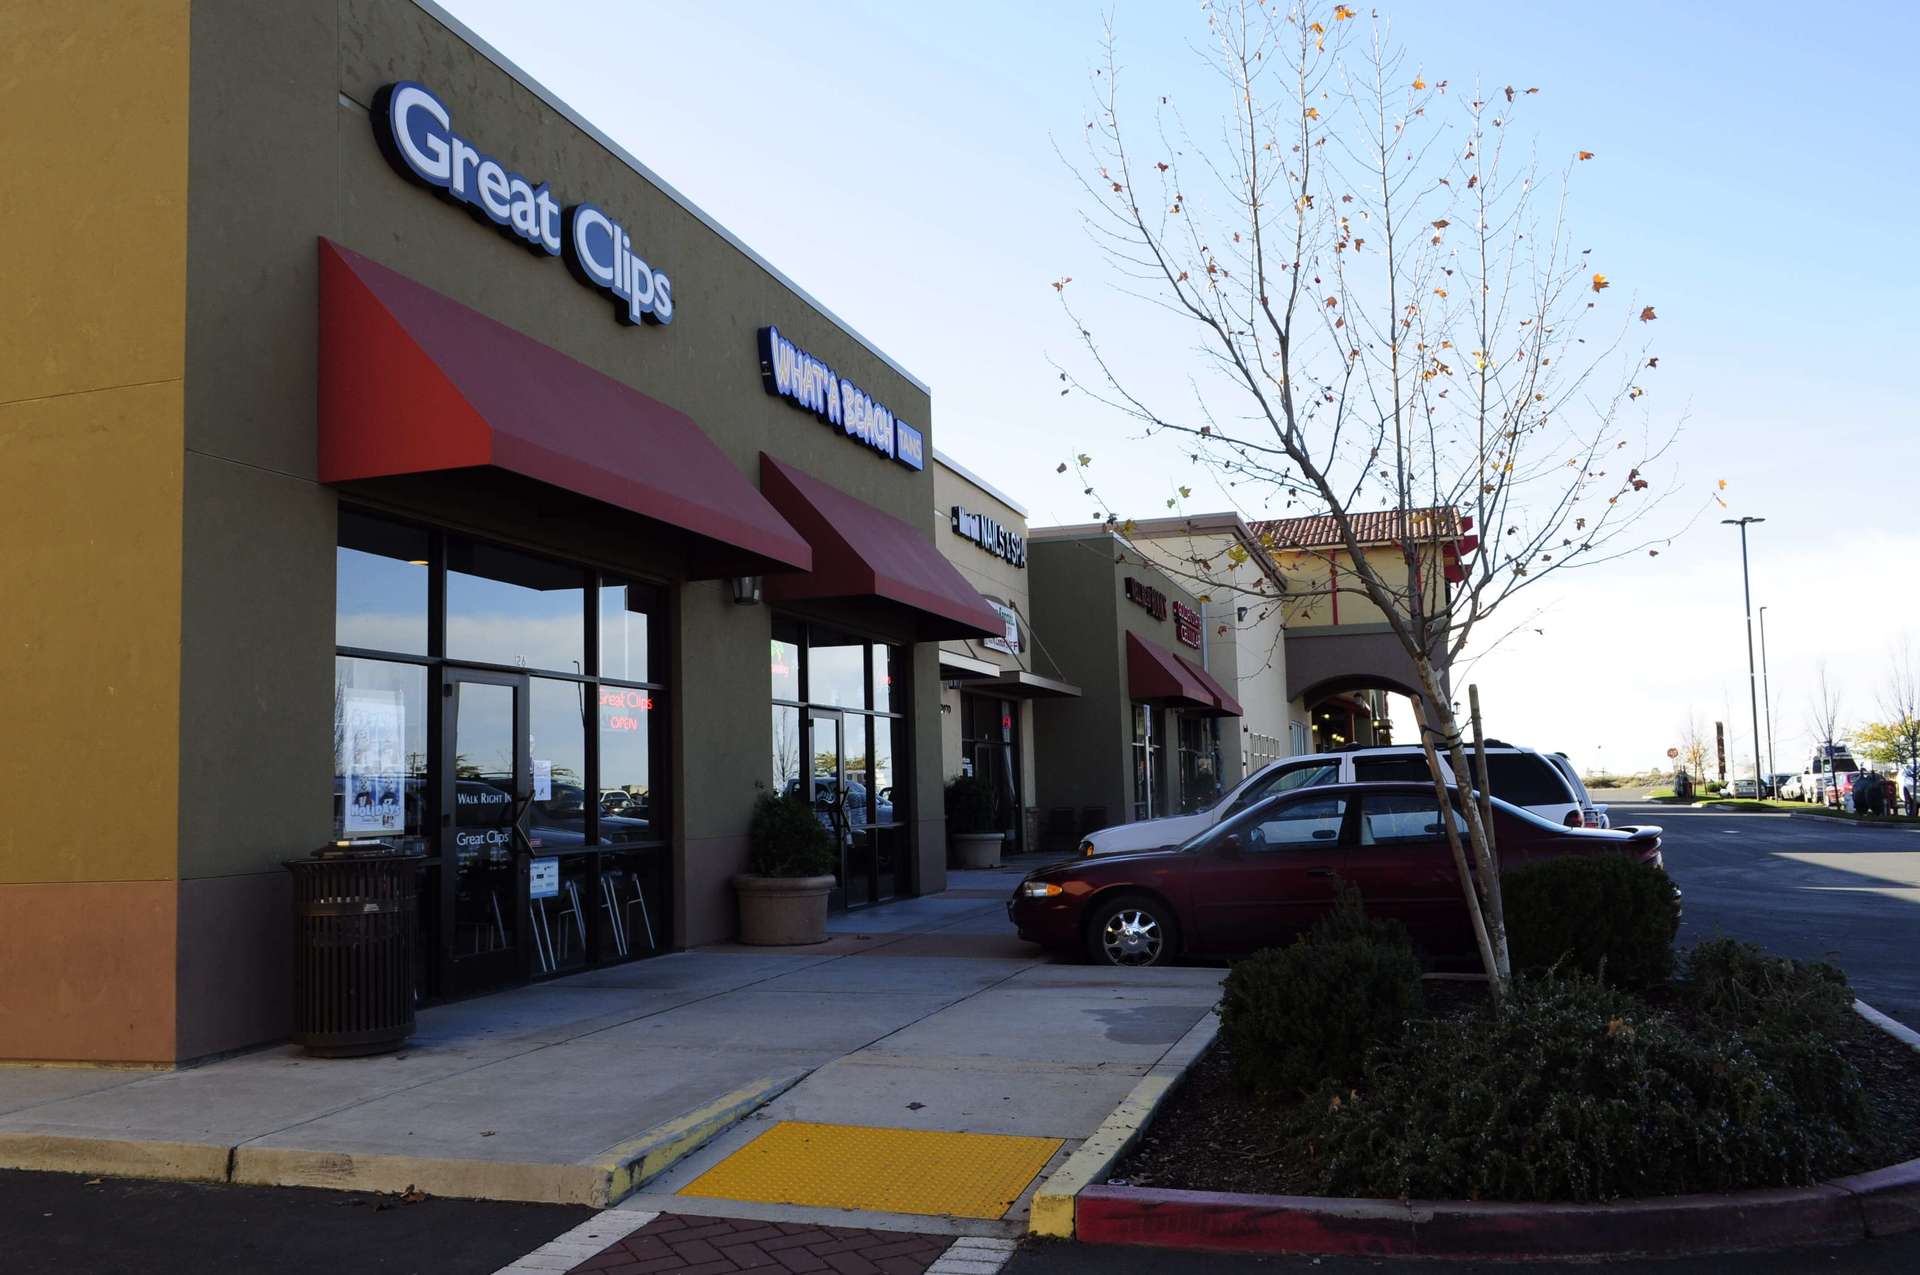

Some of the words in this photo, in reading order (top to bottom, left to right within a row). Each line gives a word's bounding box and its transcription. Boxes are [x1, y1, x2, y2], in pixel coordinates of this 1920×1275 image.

[394, 86, 561, 250] Great
[576, 208, 672, 318] Clips
[841, 380, 895, 459] BEACH
[981, 514, 1005, 558] NAILS
[1011, 532, 1025, 567] SPA
[610, 716, 638, 731] OPEN
[457, 793, 479, 804] WALK
[480, 793, 503, 804] RIGHT
[350, 804, 401, 817] HOLIDAYS
[456, 832, 486, 846] Great
[486, 830, 510, 848] Clips
